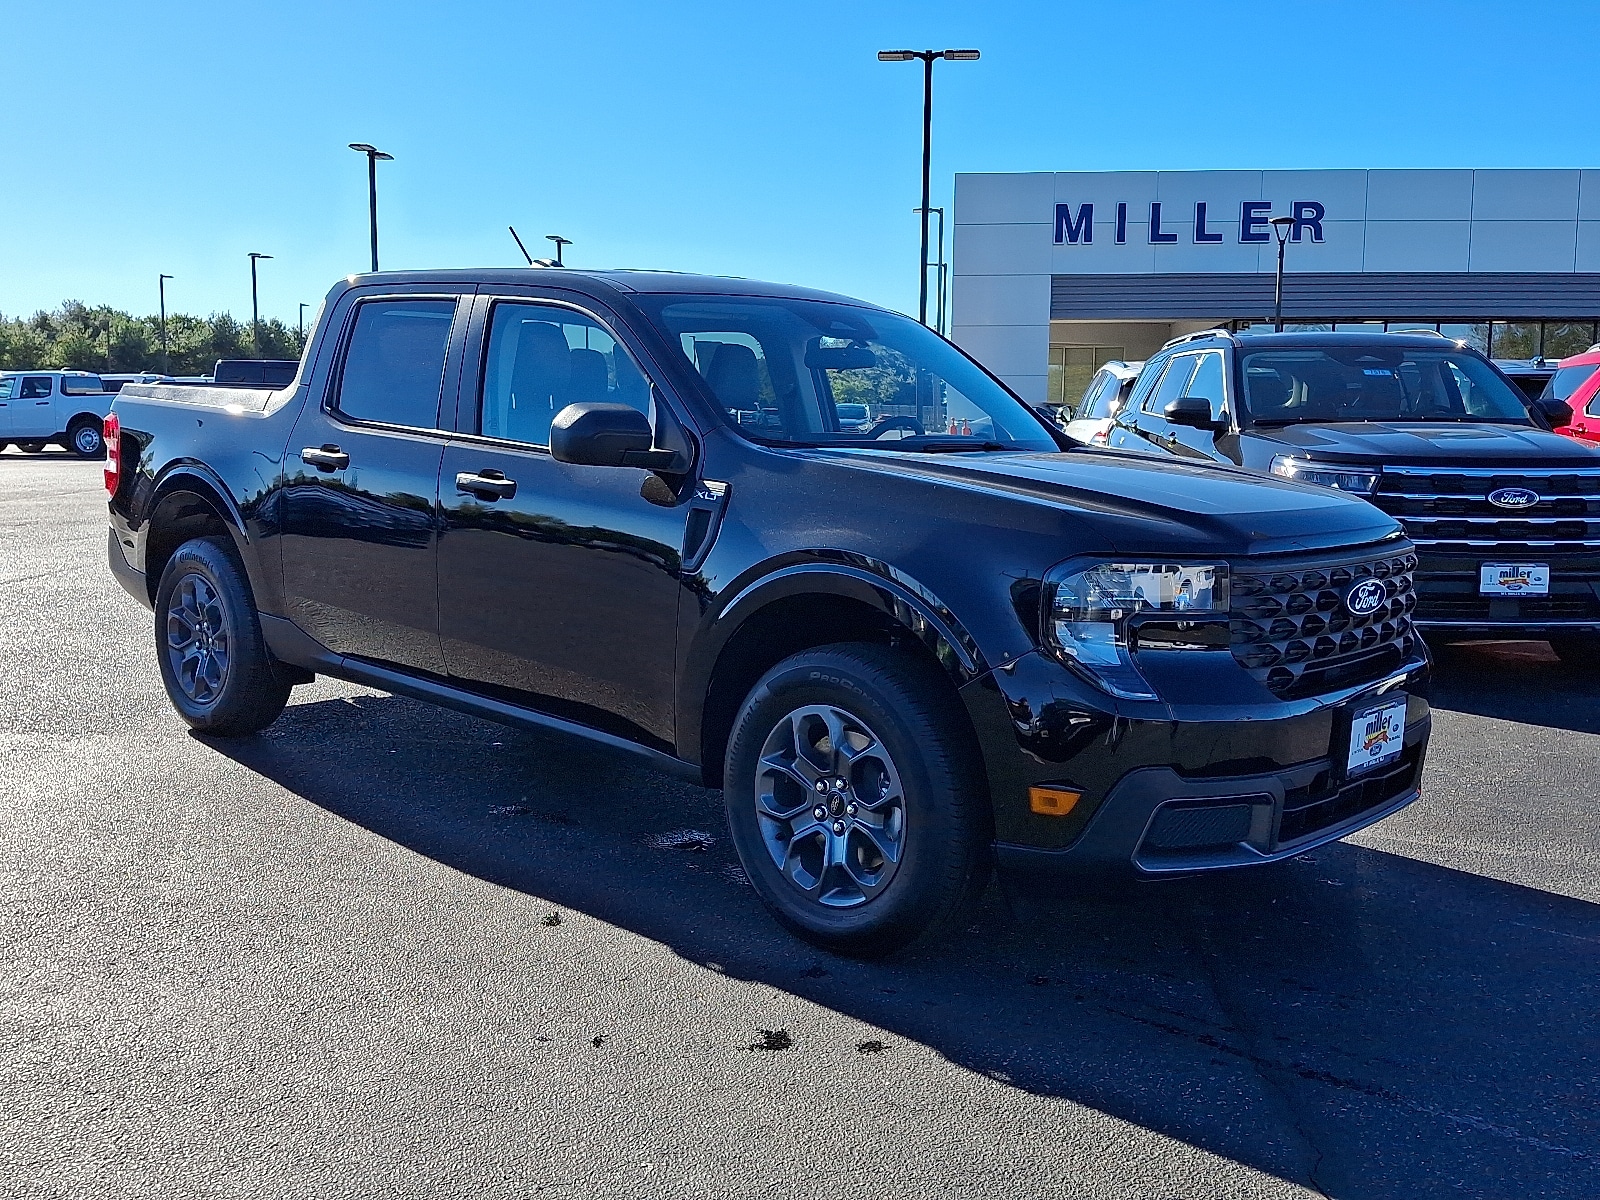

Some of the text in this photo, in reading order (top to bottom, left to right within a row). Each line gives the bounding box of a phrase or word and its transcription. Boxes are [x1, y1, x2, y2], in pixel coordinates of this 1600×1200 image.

[1053, 200, 1326, 245] MILLER
[694, 490, 723, 500] XLT
[1501, 491, 1528, 504] Ford
[1499, 567, 1532, 579] miller
[1355, 585, 1380, 609] Ford
[1365, 710, 1393, 738] miller
